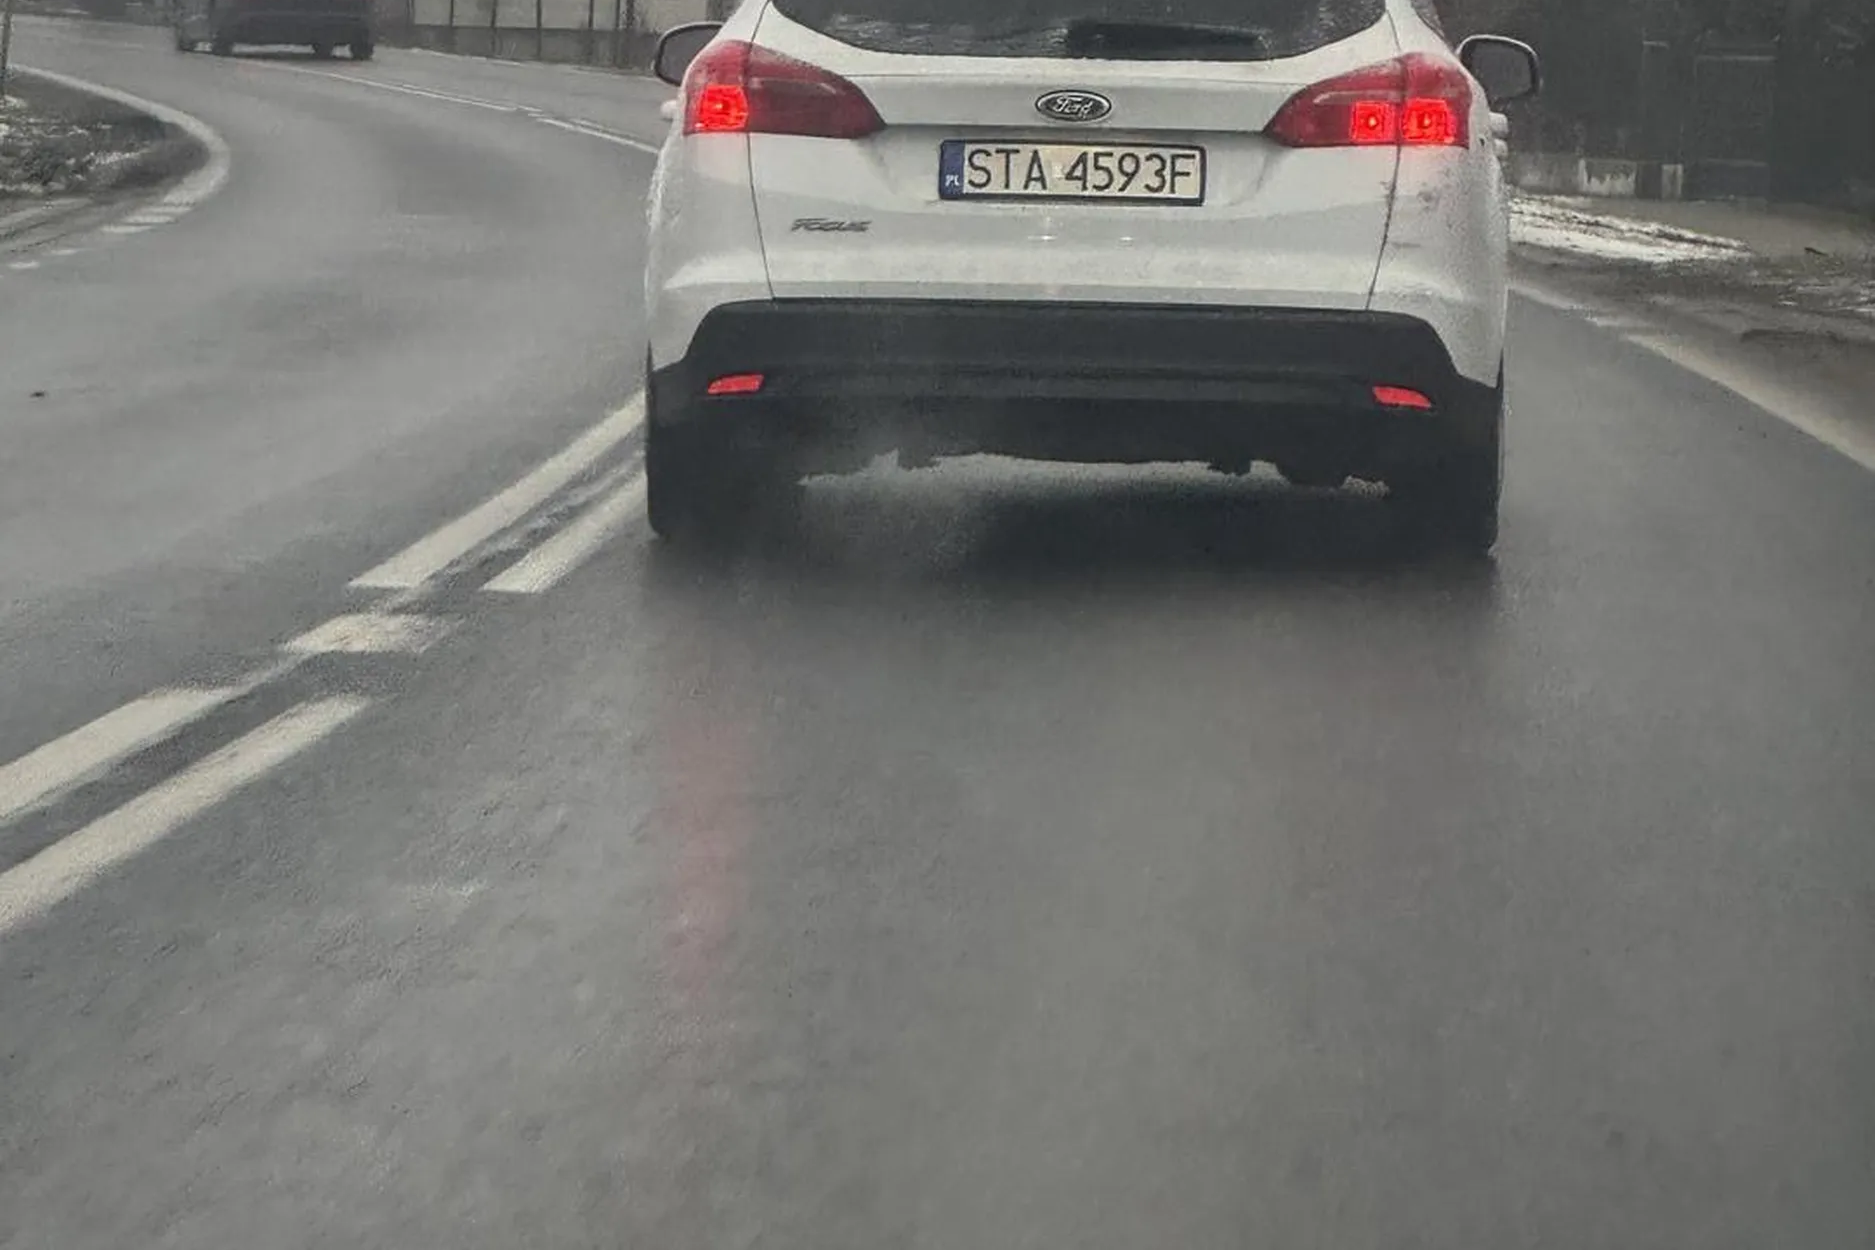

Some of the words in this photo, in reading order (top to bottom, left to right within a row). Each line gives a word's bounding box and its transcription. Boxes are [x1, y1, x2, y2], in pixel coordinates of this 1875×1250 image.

[1052, 96, 1094, 119] Ford
[967, 148, 1048, 190] STA
[1064, 150, 1197, 195] 4593F
